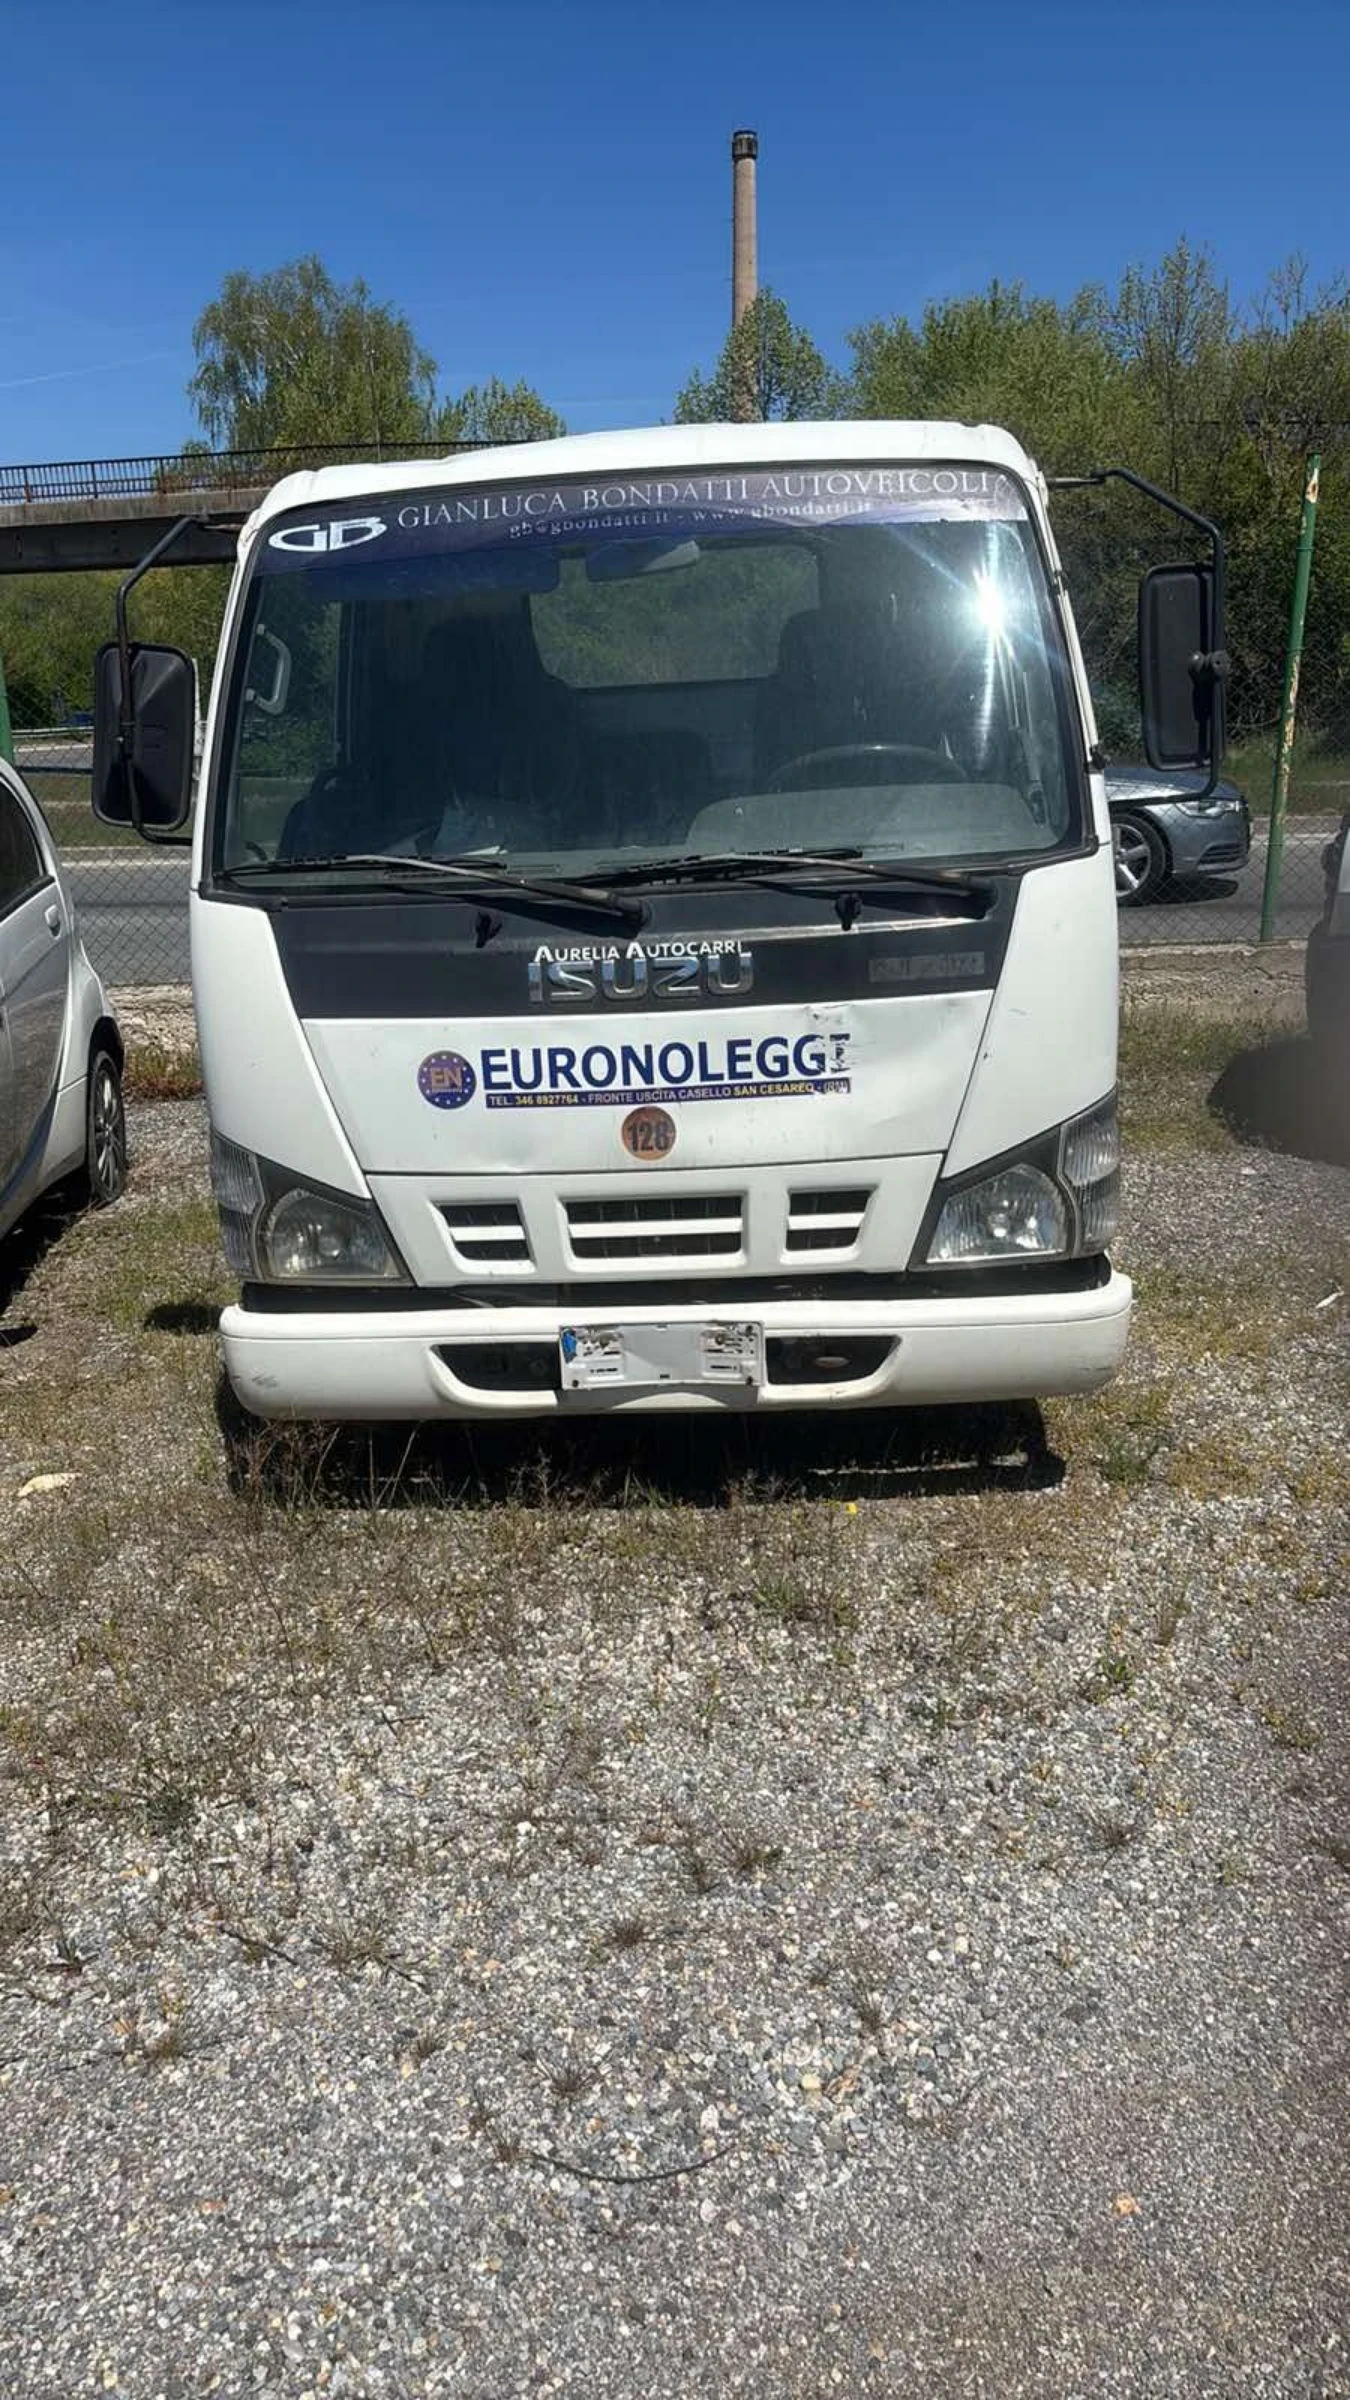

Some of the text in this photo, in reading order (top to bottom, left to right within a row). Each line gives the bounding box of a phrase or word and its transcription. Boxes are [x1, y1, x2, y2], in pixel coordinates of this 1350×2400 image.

[398, 493, 568, 529] GIANLUCA
[582, 477, 749, 511] BONDATTI
[761, 470, 990, 499] AUTOVEICOLI
[534, 940, 744, 962] AURELIA AUTOCARRI
[528, 953, 754, 1001] ISUZU
[431, 1067, 463, 1089] EN
[588, 1092, 633, 1104] FRONTE
[678, 1086, 732, 1099] CASELLO
[733, 1085, 757, 1096] SAN
